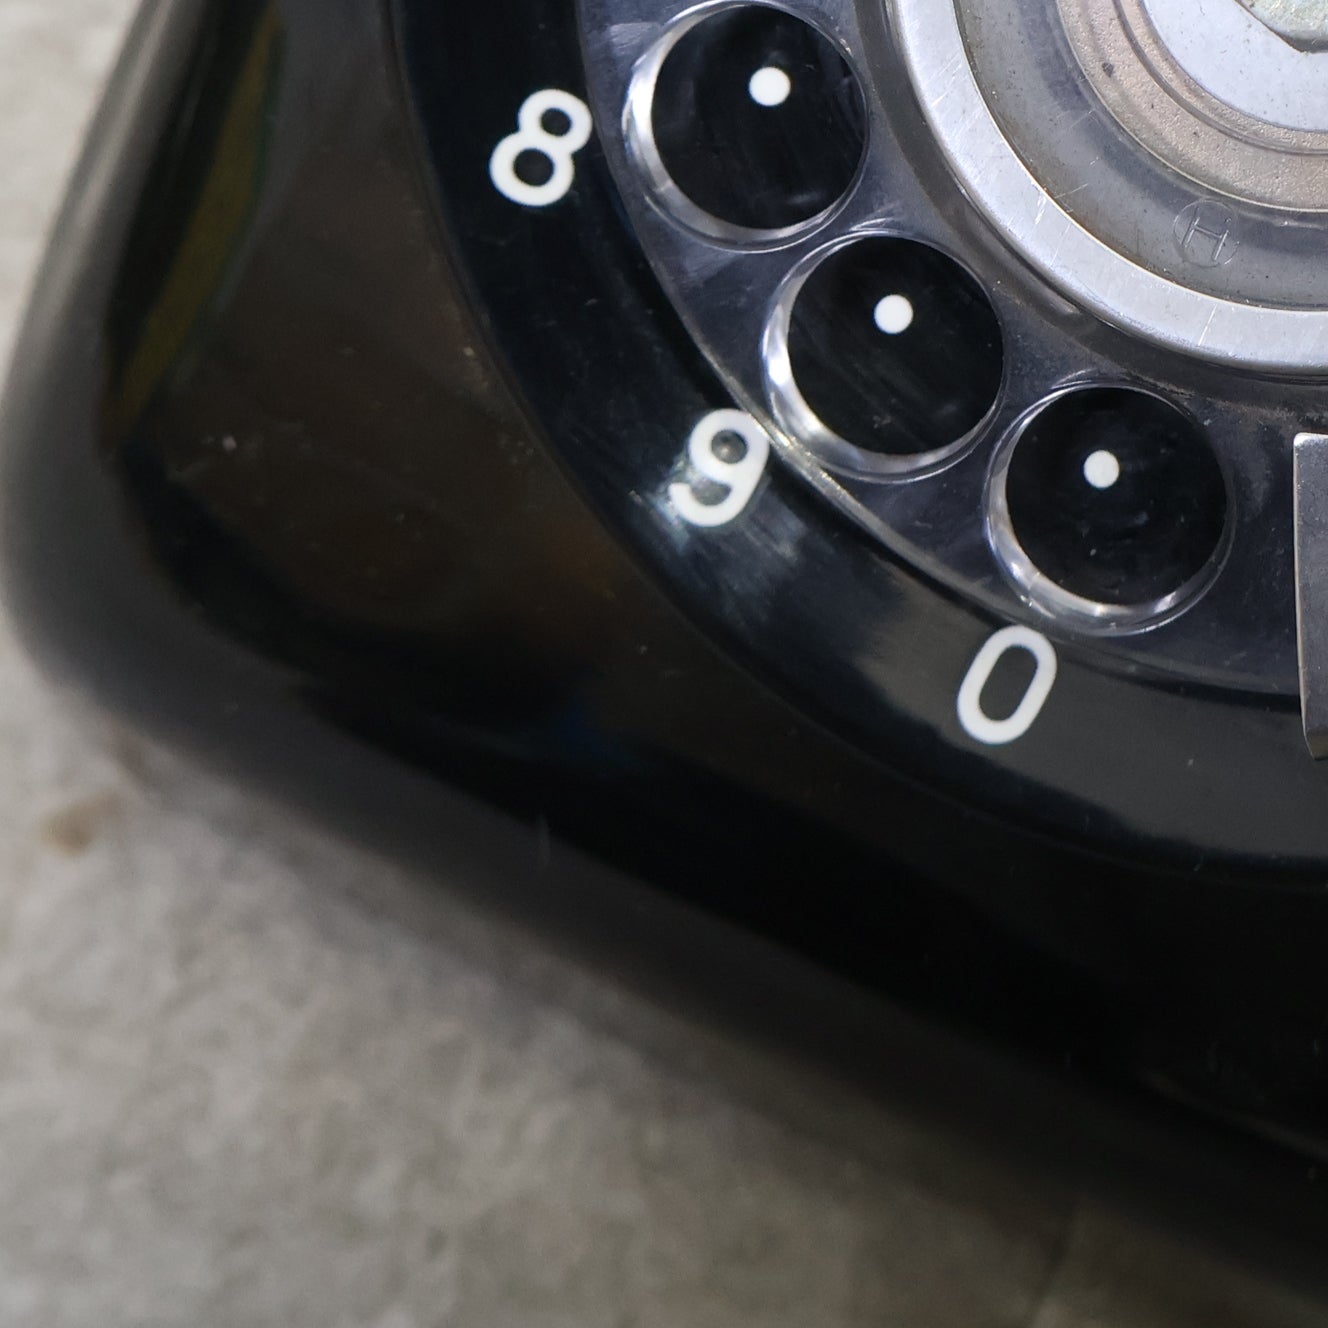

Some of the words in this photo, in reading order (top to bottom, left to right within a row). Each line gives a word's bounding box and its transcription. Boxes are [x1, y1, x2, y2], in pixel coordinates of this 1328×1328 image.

[491, 90, 591, 205] 8
[667, 407, 771, 528] 9
[958, 628, 1055, 742] 0
